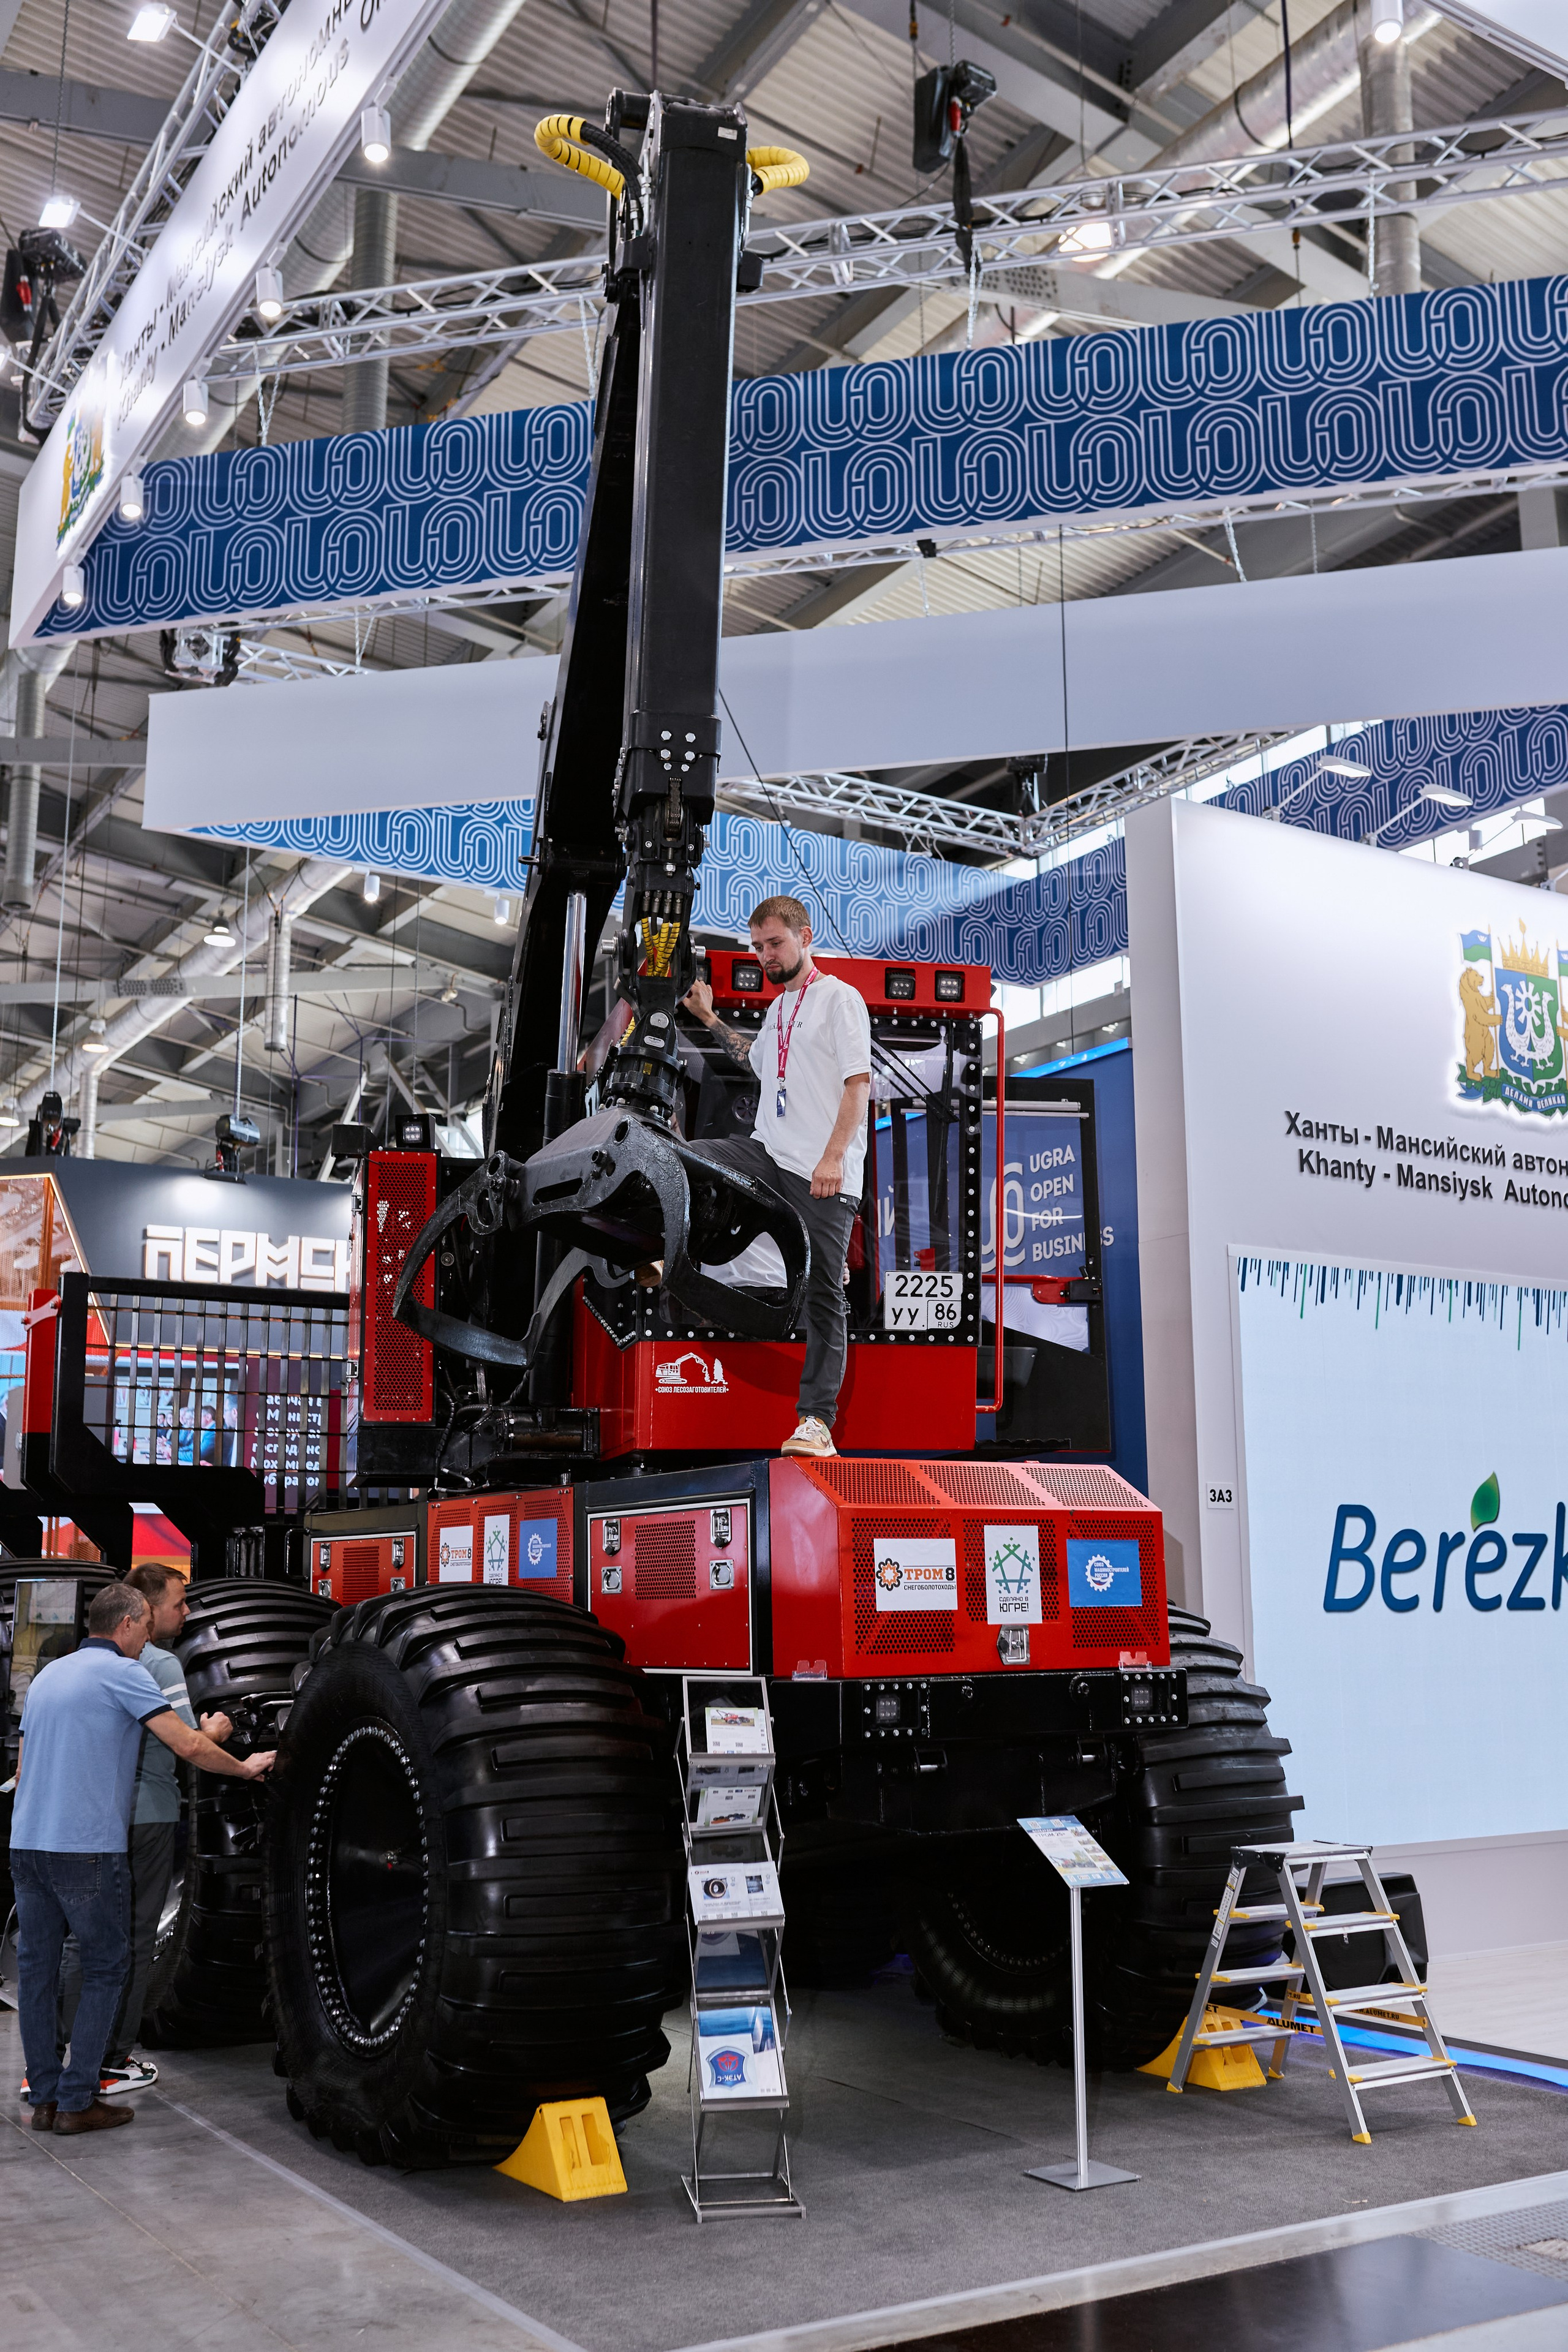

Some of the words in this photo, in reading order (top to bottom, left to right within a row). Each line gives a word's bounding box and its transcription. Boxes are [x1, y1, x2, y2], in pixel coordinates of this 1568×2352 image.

[1504, 1086, 1532, 1108] ДЕЛАМИ
[1537, 1095, 1566, 1109] ВЕЛИКАЯ
[1284, 1110, 1359, 1145] Ханты
[1376, 1125, 1506, 1167] Мансийский
[1030, 1144, 1076, 1173] UGRA
[1298, 1148, 1376, 1188] Khanty
[1397, 1163, 1493, 1200] Mansiysk
[1030, 1174, 1074, 1202] OPEN
[1032, 1207, 1063, 1231] FOR
[1032, 1226, 1114, 1262] BUSINS
[895, 1275, 953, 1298] 2225
[935, 1303, 957, 1321] 86
[673, 1385, 726, 1393] ЛЕСОЗАГОТОВИТЕЛЕЙ
[451, 1549, 467, 1559] ТРОМ
[467, 1548, 472, 1559] 8
[903, 1568, 944, 1581] ТРОМ
[945, 1567, 955, 1581] 8
[1000, 1603, 1029, 1613] ЮГРЕ!
[1267, 2016, 1316, 2034] ALUMET
[717, 2073, 742, 2083] АТЭК-С
